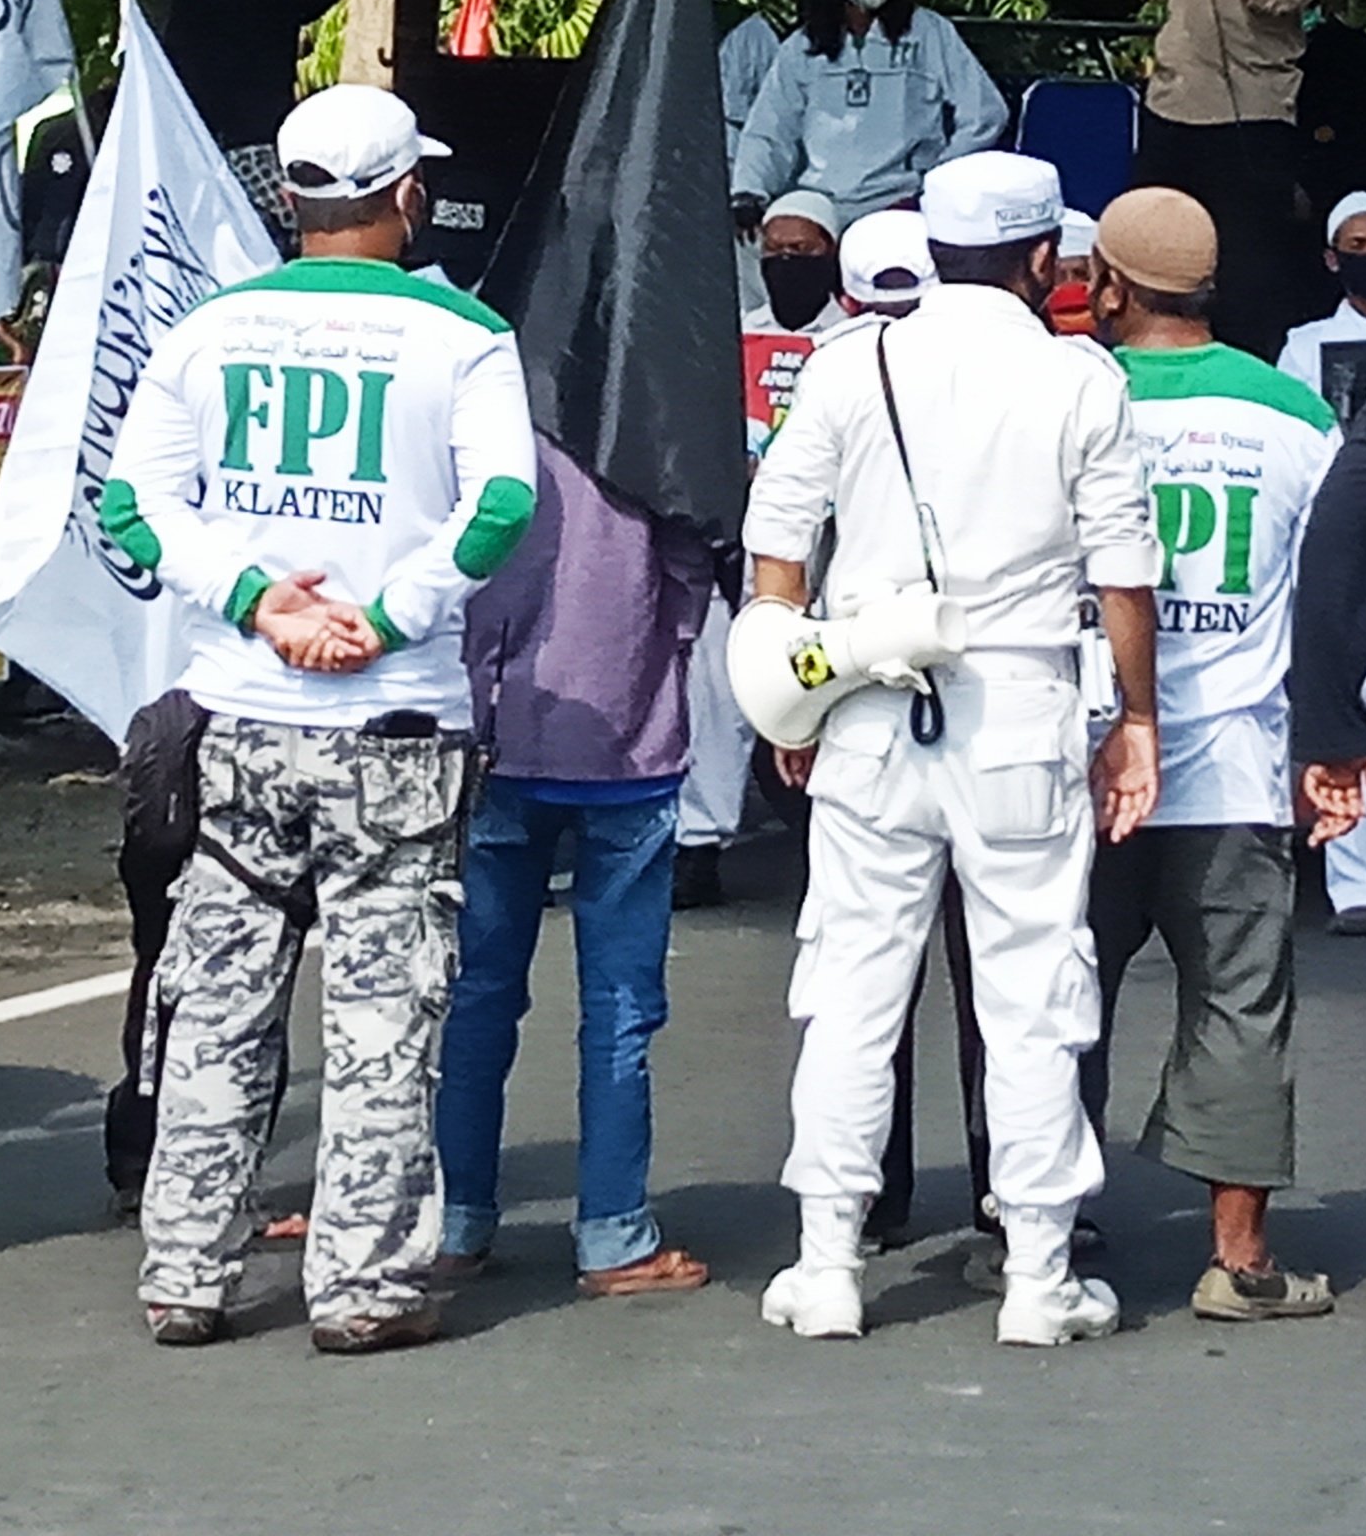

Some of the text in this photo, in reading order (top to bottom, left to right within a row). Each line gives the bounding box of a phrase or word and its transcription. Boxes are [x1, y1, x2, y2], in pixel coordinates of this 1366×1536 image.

[219, 362, 395, 483] FPI
[223, 478, 386, 525] KLATEN
[1145, 482, 1260, 595] PI
[1156, 598, 1250, 636] TEN
